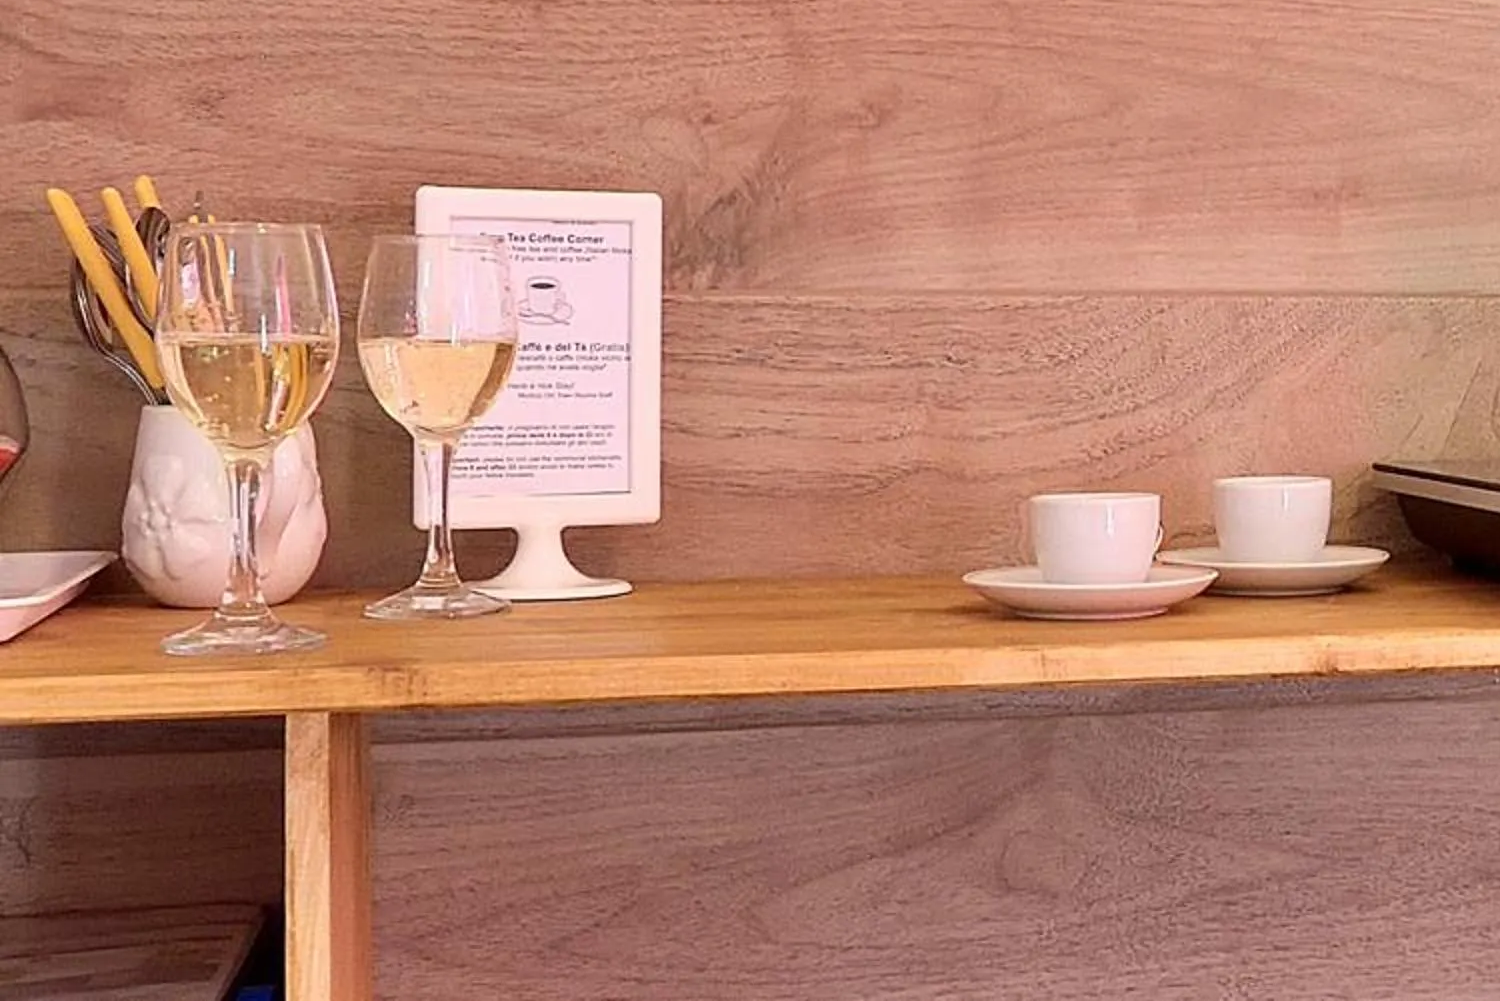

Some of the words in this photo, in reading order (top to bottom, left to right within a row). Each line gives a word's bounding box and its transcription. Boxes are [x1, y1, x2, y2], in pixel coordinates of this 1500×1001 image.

[508, 232, 525, 242] Tea
[528, 232, 564, 243] Coffee
[568, 234, 604, 244] Corner
[555, 343, 571, 351] del
